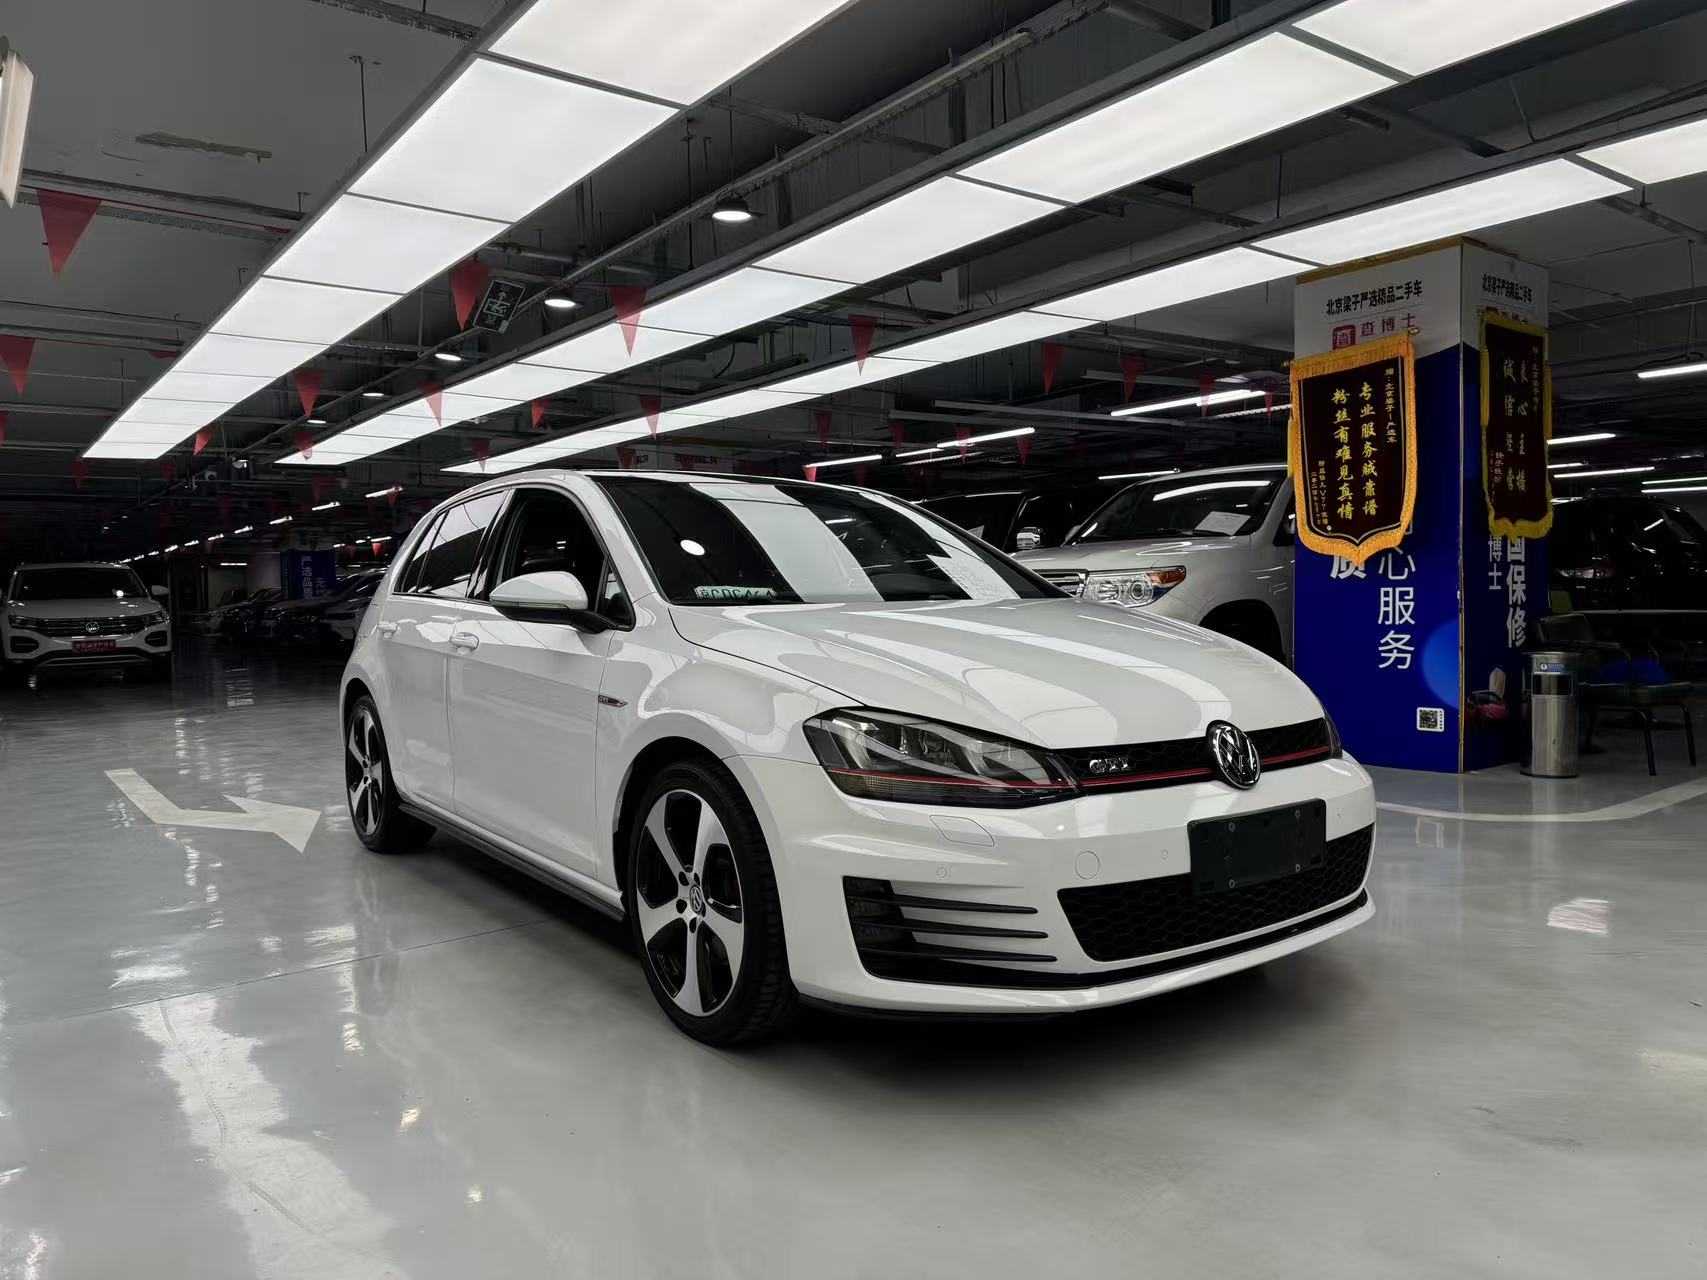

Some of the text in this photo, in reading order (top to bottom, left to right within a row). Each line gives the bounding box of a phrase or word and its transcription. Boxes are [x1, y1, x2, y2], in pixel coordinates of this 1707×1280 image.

[1326, 280, 1423, 316] 北京梁子严选精品二手车
[1331, 387, 1354, 521] 粉丝有难见真情
[1089, 757, 1129, 774] GTI
